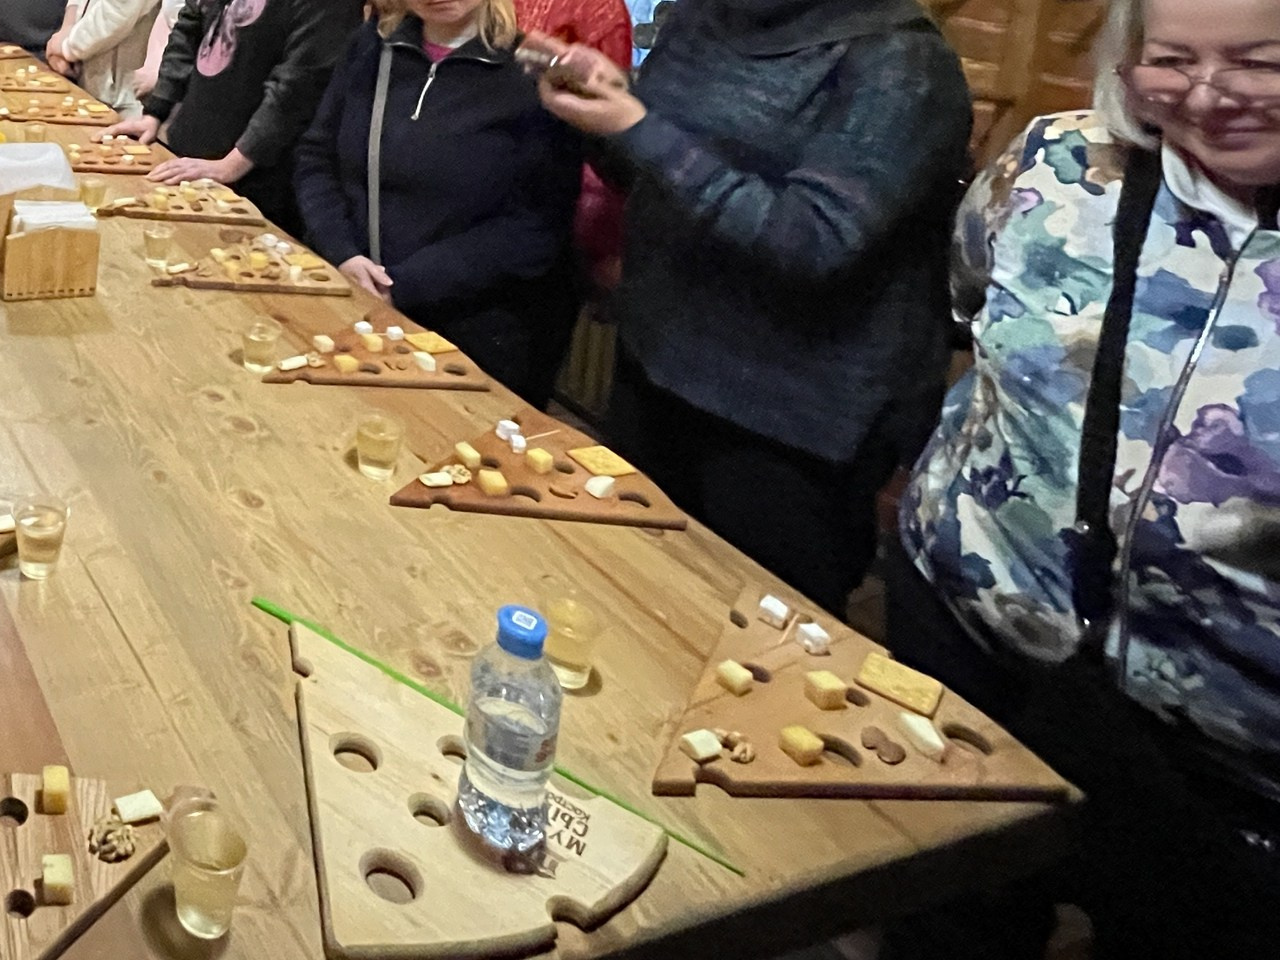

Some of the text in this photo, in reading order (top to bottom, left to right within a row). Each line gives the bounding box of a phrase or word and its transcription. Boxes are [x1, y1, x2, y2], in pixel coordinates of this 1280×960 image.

[546, 792, 590, 821] Костро
[551, 807, 588, 837] СЫ
[548, 829, 586, 857] МУ
